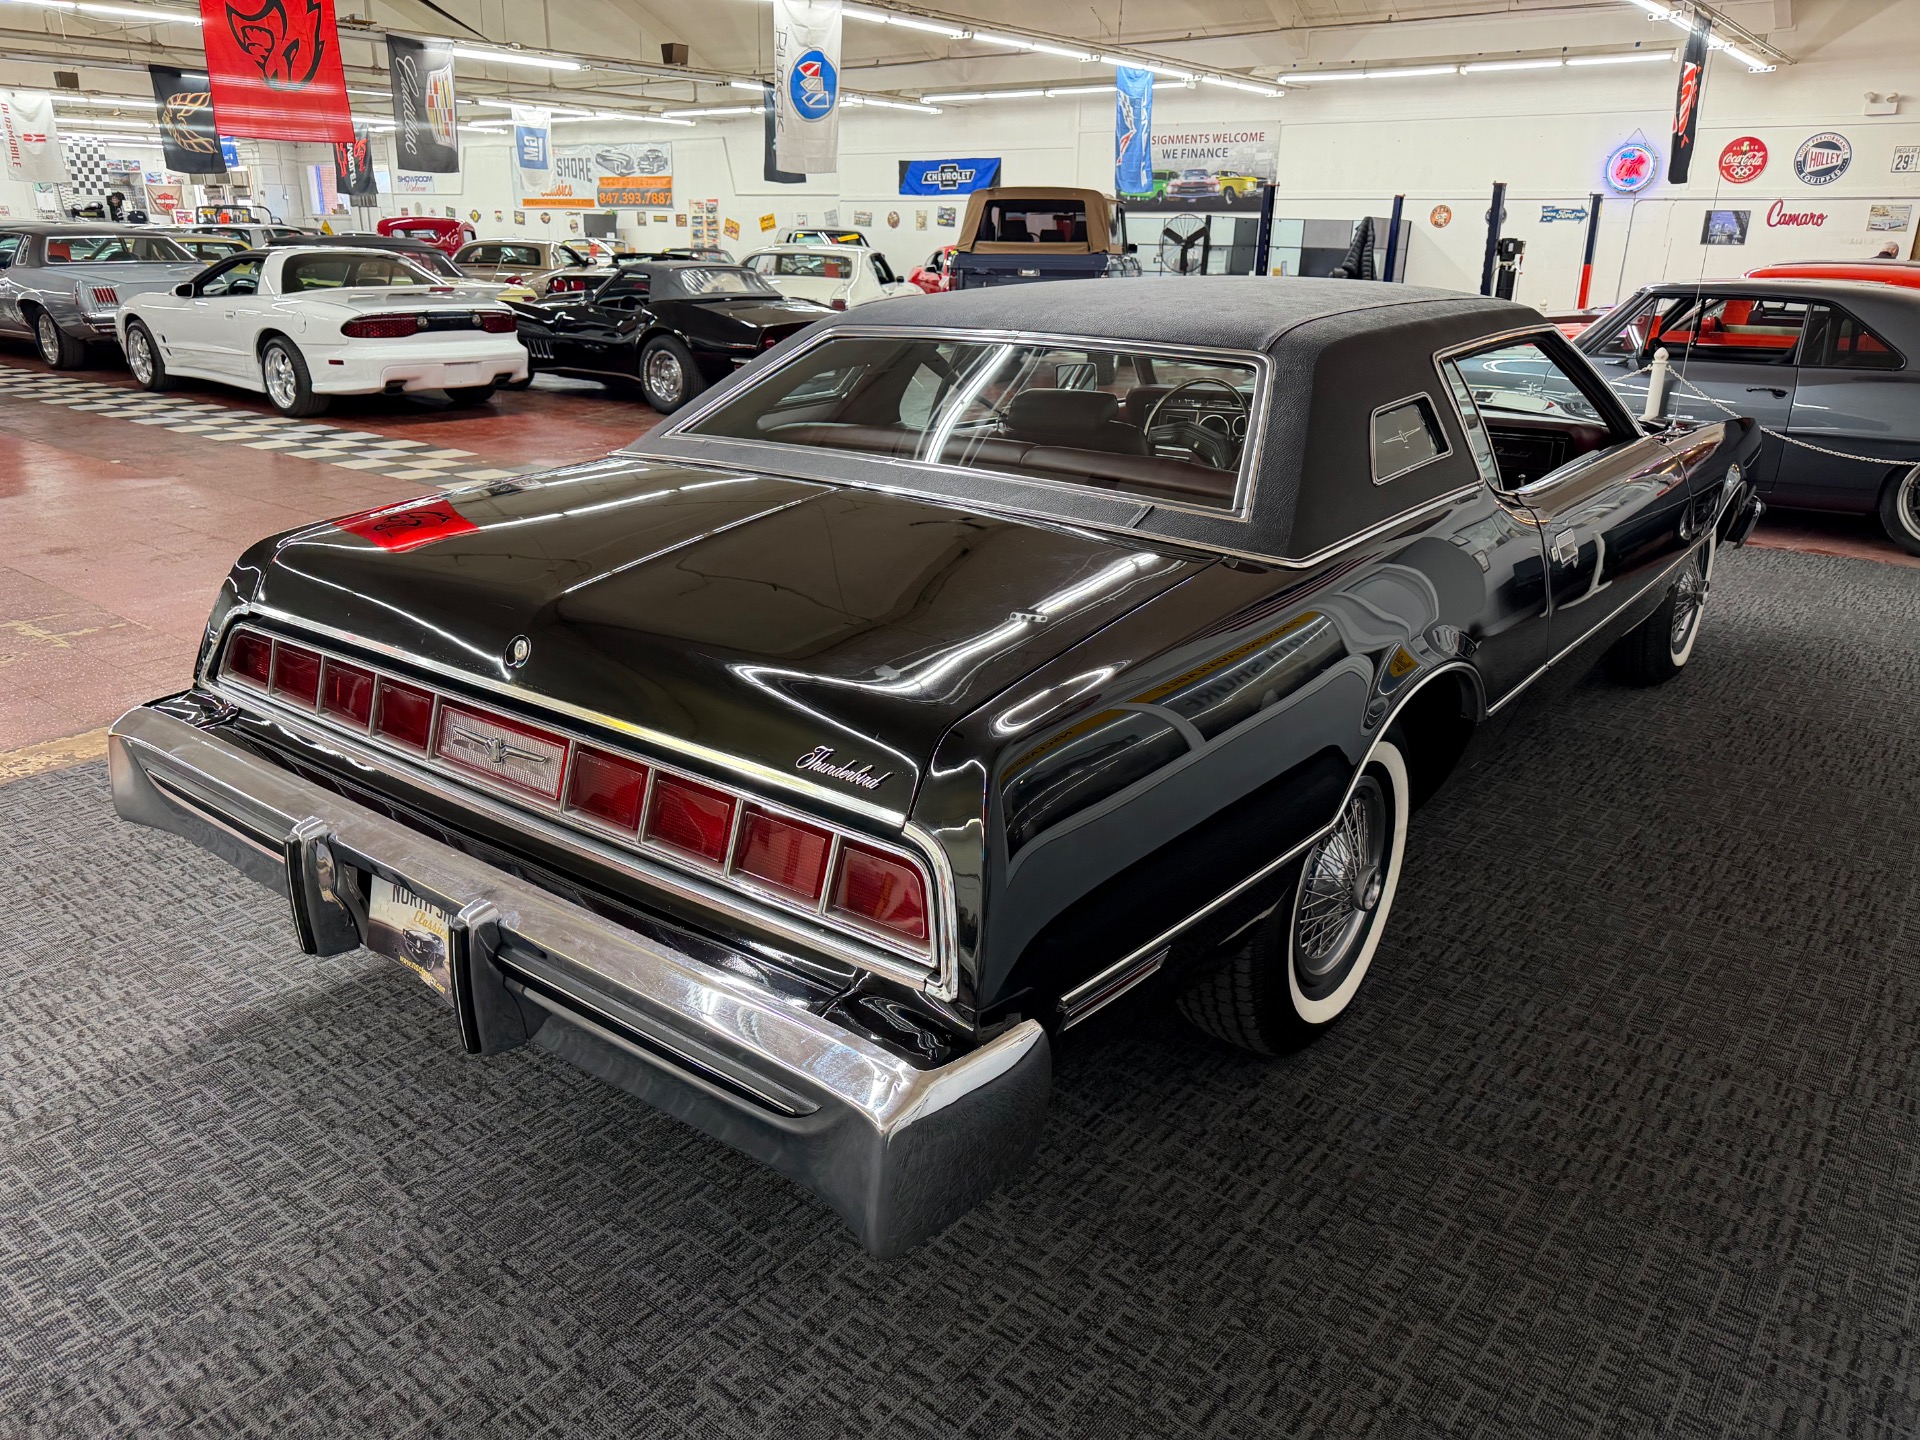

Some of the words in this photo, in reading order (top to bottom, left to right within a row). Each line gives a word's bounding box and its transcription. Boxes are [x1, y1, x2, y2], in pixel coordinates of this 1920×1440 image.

[775, 29, 788, 133] BUICK
[395, 55, 420, 155] Cadillac
[1, 103, 22, 168] OLDSMOBILE
[1151, 133, 1210, 145] SIGNMENTS
[1212, 131, 1265, 144] WELCOME
[1812, 135, 1849, 156] PERFORMANCE
[1162, 149, 1178, 160] WE
[1181, 147, 1229, 160] FINANCE
[1808, 150, 1841, 169] HOLLEY
[1894, 154, 1910, 171] 29
[556, 157, 593, 183] SHORE
[926, 171, 971, 182] CHEVROLET
[1800, 169, 1841, 184] EQUIPPED
[599, 191, 673, 206] 847.393.7887
[1766, 197, 1828, 228] Camaro
[795, 745, 894, 790] Thunderbird
[413, 910, 449, 939] Classics
